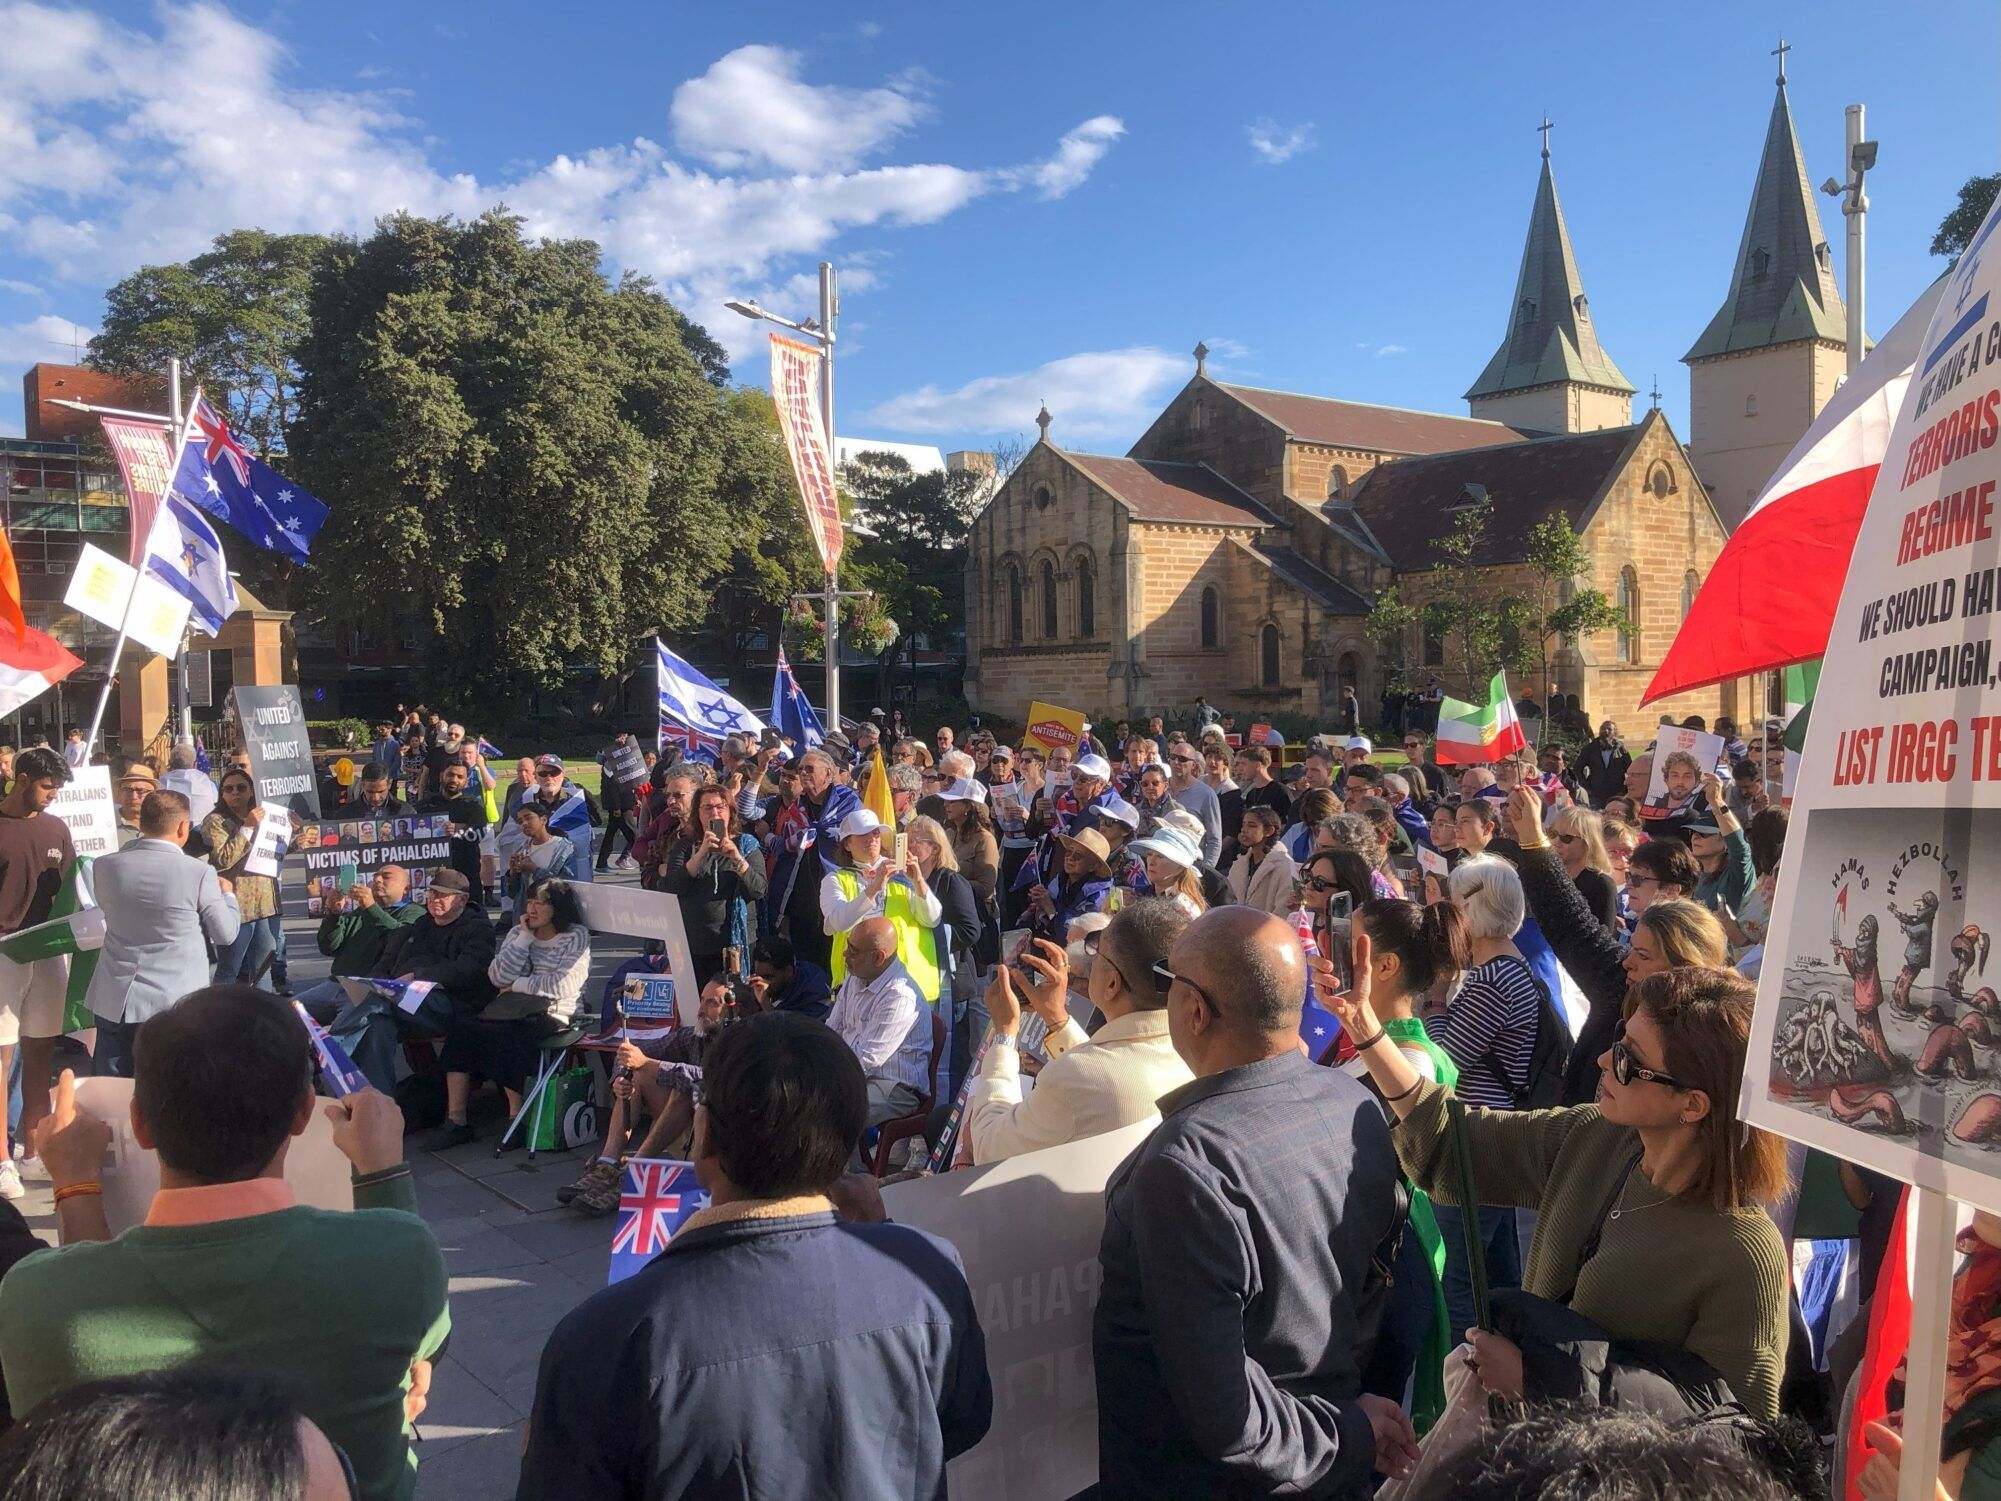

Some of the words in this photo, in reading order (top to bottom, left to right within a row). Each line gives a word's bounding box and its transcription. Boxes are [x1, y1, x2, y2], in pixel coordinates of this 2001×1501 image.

[1913, 373, 1937, 424] WE
[1931, 342, 1970, 406] HAVE
[1967, 331, 1983, 378] A
[1985, 321, 2001, 367] C
[1896, 480, 1996, 567] REGIME
[1859, 599, 1883, 643] WE
[1883, 578, 1956, 635] SHOULD
[1961, 567, 2001, 618] HA
[1879, 639, 1996, 699] CAMPAIGN,
[256, 706, 291, 726] UNITED
[1031, 725, 1077, 743] ANTISEMITE
[262, 741, 299, 761] AGAINST
[612, 745, 631, 758] UNITED
[1833, 726, 1884, 786] LIST
[1886, 719, 1959, 784] IRGC
[616, 757, 638, 771] AGAINST
[618, 767, 646, 784] TERRORISM
[260, 774, 312, 797] TERRORISM
[269, 812, 286, 827] UNITED
[307, 850, 360, 870] VICTIMS
[362, 848, 378, 865] OF
[381, 842, 450, 863] PAHALGAM
[1831, 858, 1870, 890] HAMAS
[1886, 842, 1963, 901] HEZBOLLAH
